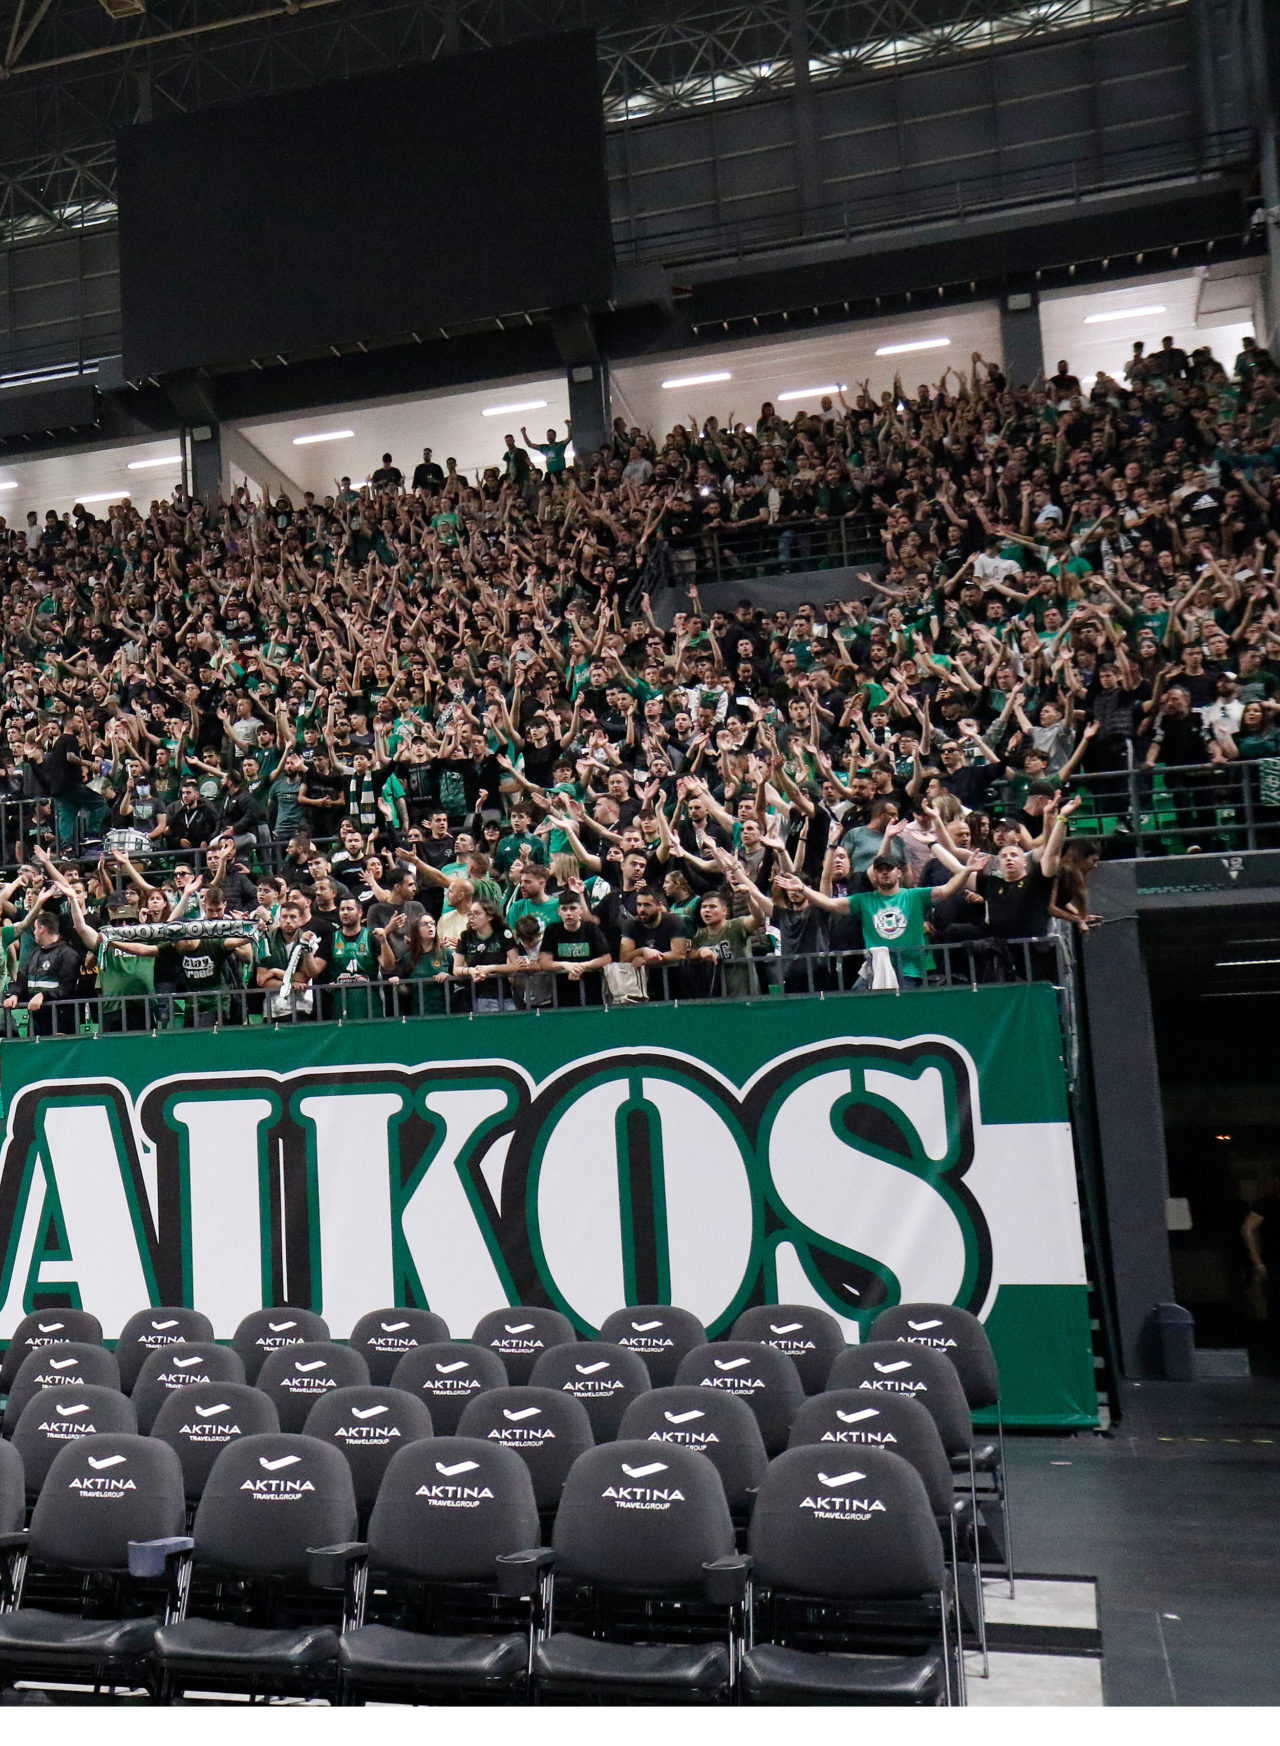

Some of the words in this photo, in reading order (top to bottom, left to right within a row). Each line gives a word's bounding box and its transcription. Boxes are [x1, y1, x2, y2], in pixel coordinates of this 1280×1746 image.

[368, 1338, 418, 1346] AKTINA
[618, 1338, 673, 1346] AKTINA
[34, 1376, 84, 1384] AKTINA
[157, 1374, 210, 1383] AKTINA
[281, 1378, 336, 1386] AKTINA
[700, 1378, 765, 1387] AKTINA
[423, 1380, 480, 1388] AKTINA
[563, 1381, 624, 1390] AKTINA
[859, 1381, 927, 1390] AKTINA
[38, 1423, 96, 1432] AKTINA
[179, 1425, 241, 1434] AKTINA
[335, 1427, 400, 1437] AKTINA
[488, 1429, 555, 1439] AKTINA
[648, 1432, 719, 1442] AKTINA
[821, 1432, 897, 1442] AKTINA
[69, 1479, 136, 1489] AKTINA
[240, 1480, 315, 1491] AKTINA
[416, 1486, 494, 1498] AKTINA
[602, 1488, 684, 1500] AKTINA
[428, 1499, 480, 1507] TRAVELGROUP
[615, 1501, 670, 1509] TRAVELGROUP
[800, 1497, 886, 1511] AKTINA
[814, 1511, 871, 1520] TRAVELGROUP
